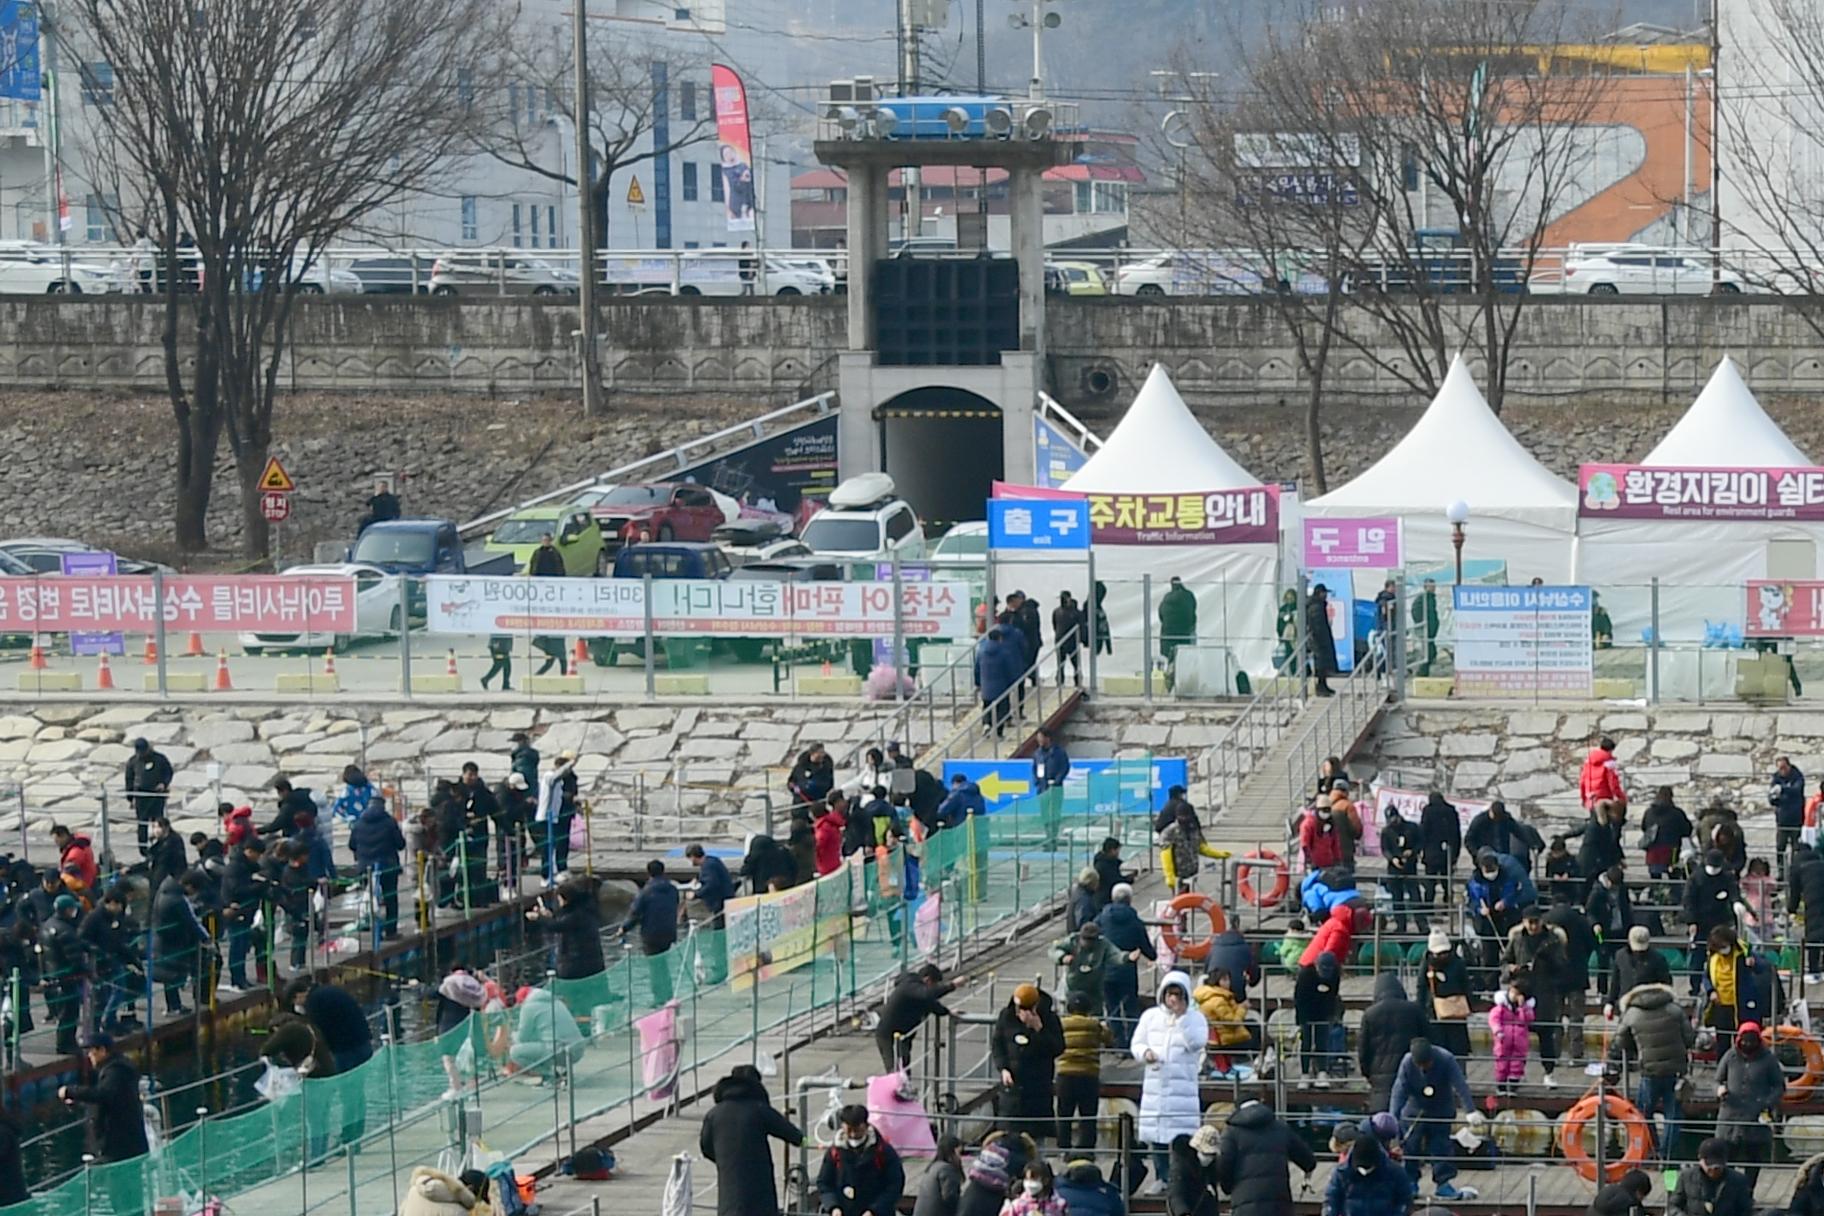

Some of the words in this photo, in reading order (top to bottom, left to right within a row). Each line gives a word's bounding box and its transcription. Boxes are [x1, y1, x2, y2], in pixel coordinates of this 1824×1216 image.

[1625, 471, 1769, 505] 환경지킴이
[265, 509, 287, 519] STOP
[1089, 494, 1267, 530] 주차교통안내
[1663, 506, 1682, 516] Rest
[1683, 507, 1702, 516] area
[1703, 507, 1714, 516] for
[1715, 507, 1766, 517] environment
[1768, 508, 1796, 518] guards
[1033, 535, 1052, 545] exit
[1137, 530, 1164, 541] Traffic
[1165, 531, 1215, 541] Information
